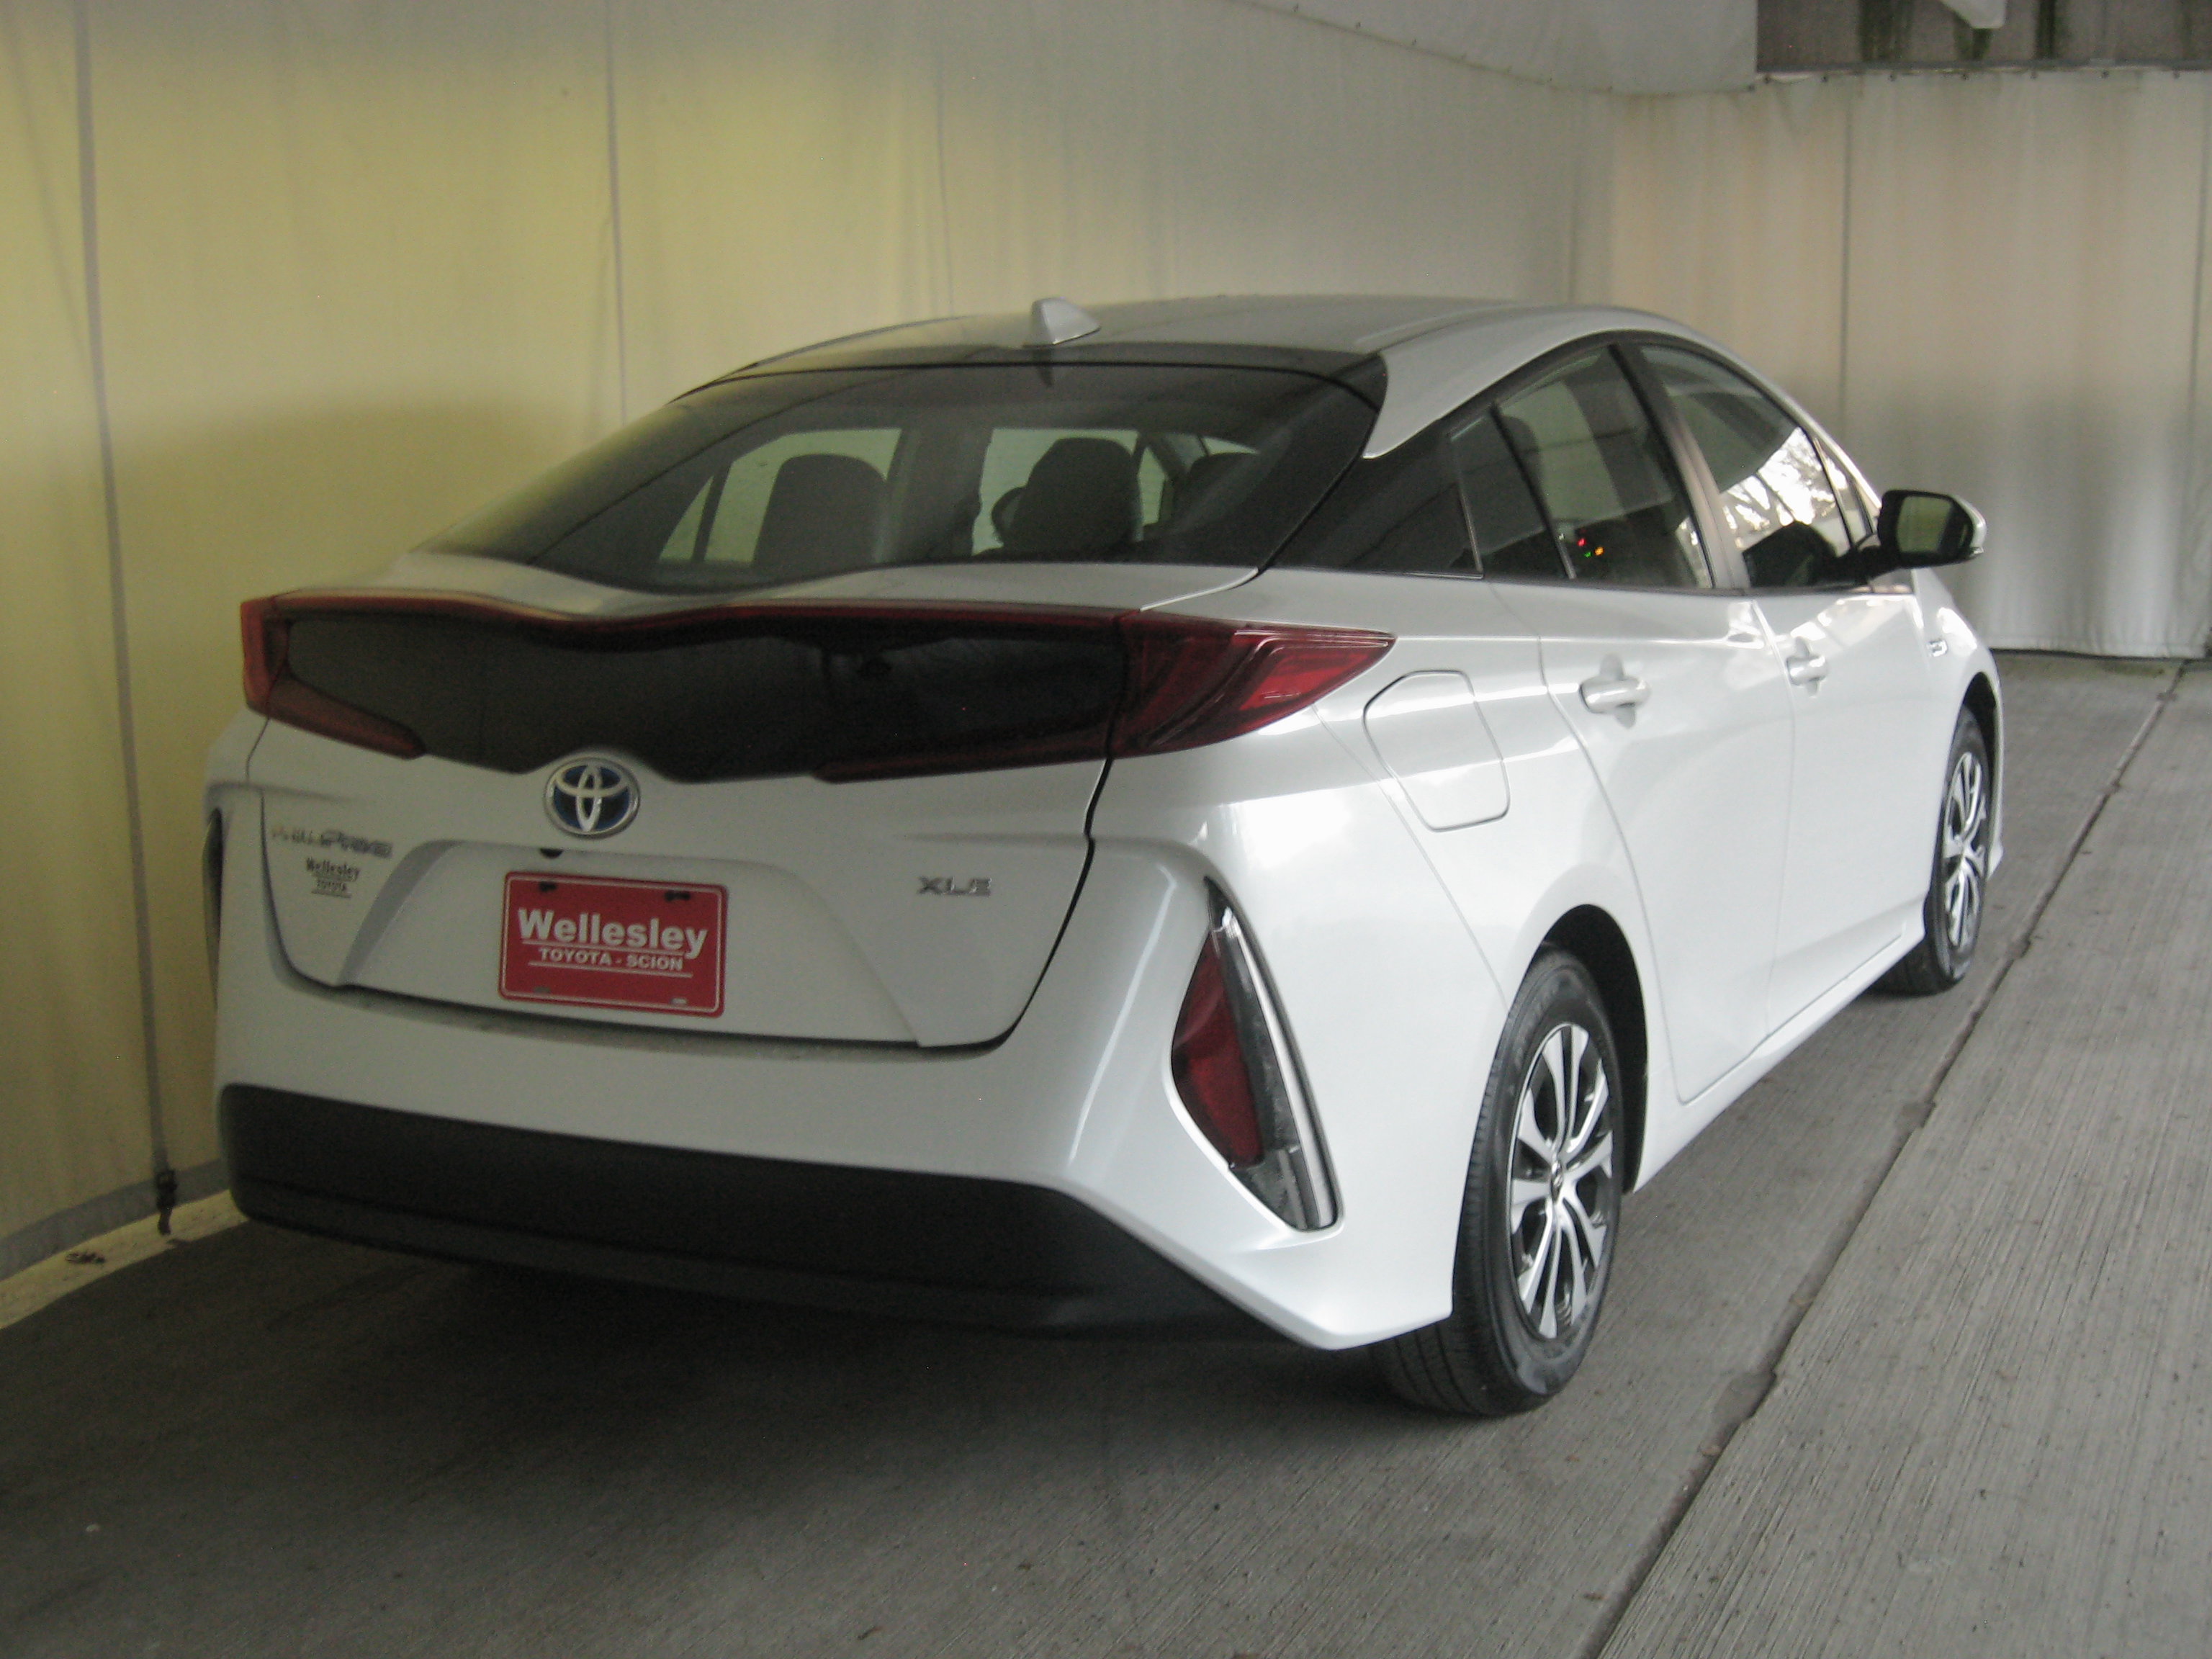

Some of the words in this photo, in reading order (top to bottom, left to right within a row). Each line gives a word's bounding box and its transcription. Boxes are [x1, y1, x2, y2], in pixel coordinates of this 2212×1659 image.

[517, 907, 709, 959] Wellesley
[539, 947, 612, 965] TOYOTA
[625, 955, 684, 971] SCION
